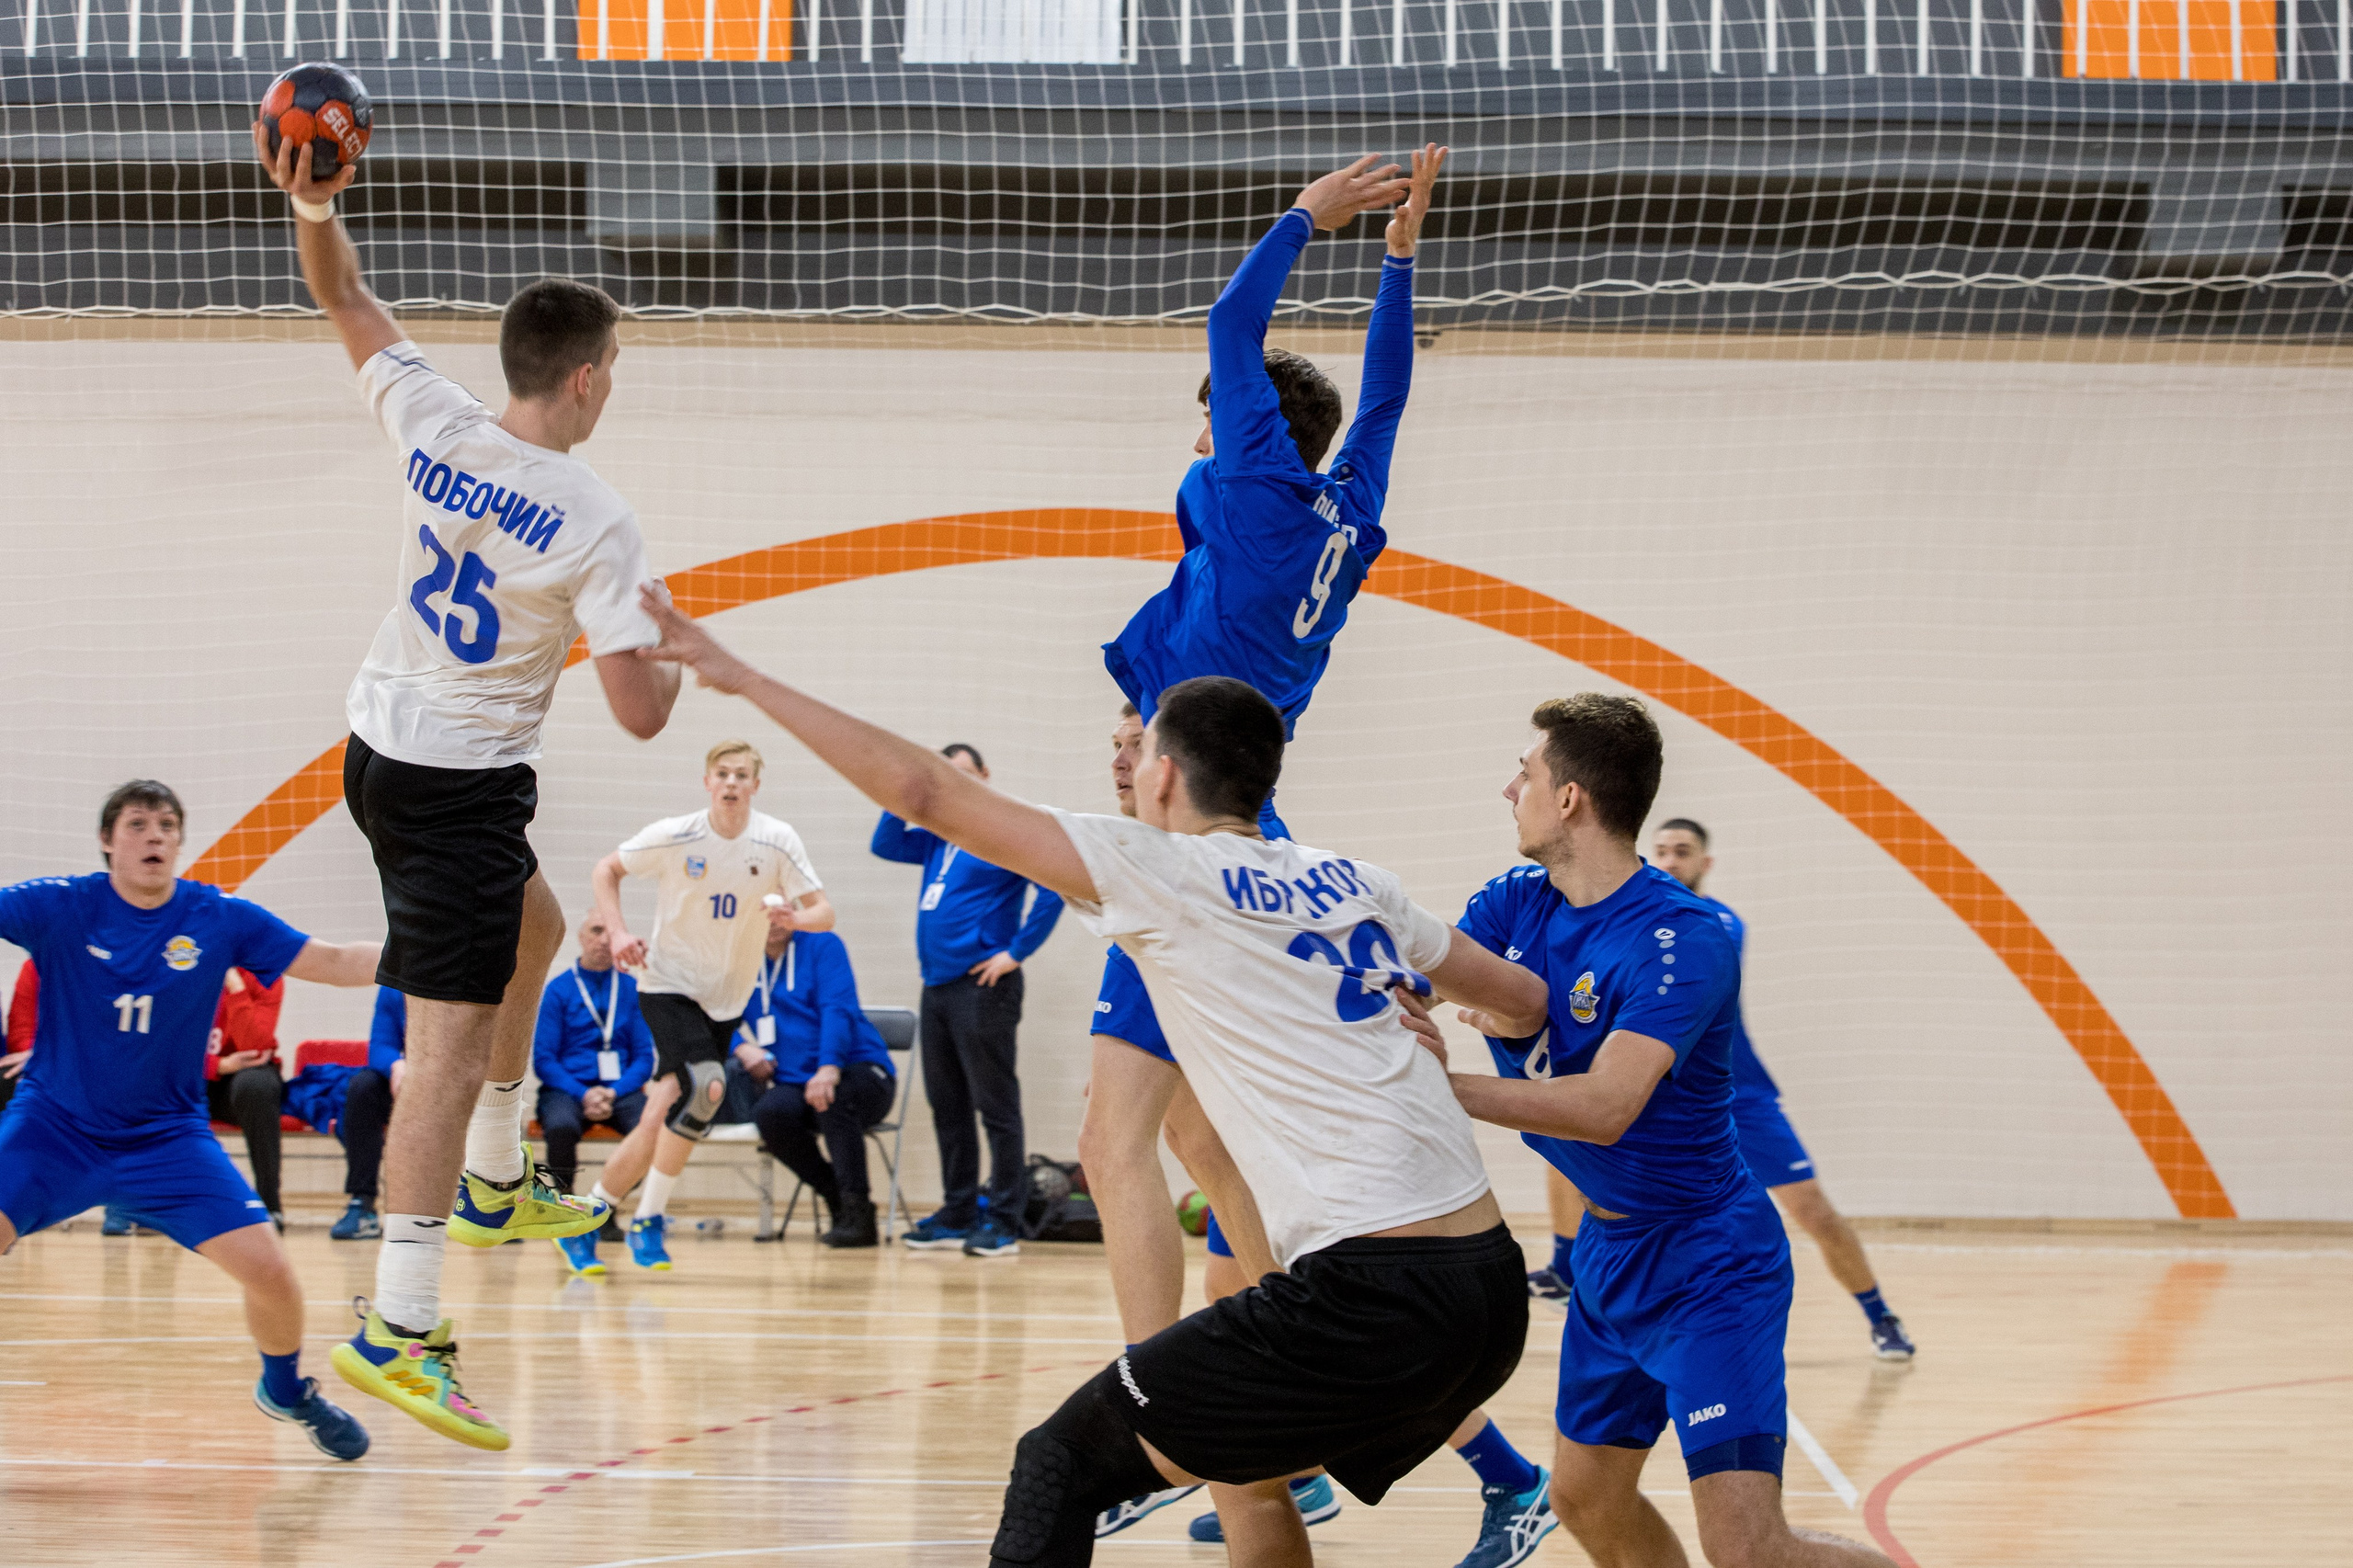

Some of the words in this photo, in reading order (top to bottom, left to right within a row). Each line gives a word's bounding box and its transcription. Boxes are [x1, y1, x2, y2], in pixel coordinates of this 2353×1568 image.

[406, 448, 566, 554] ПОБОЧИЙ
[410, 523, 500, 664] 25
[1292, 531, 1348, 639] 9
[709, 893, 737, 919] 10
[113, 994, 153, 1034] 11
[1688, 1403, 1727, 1427] JAKO
